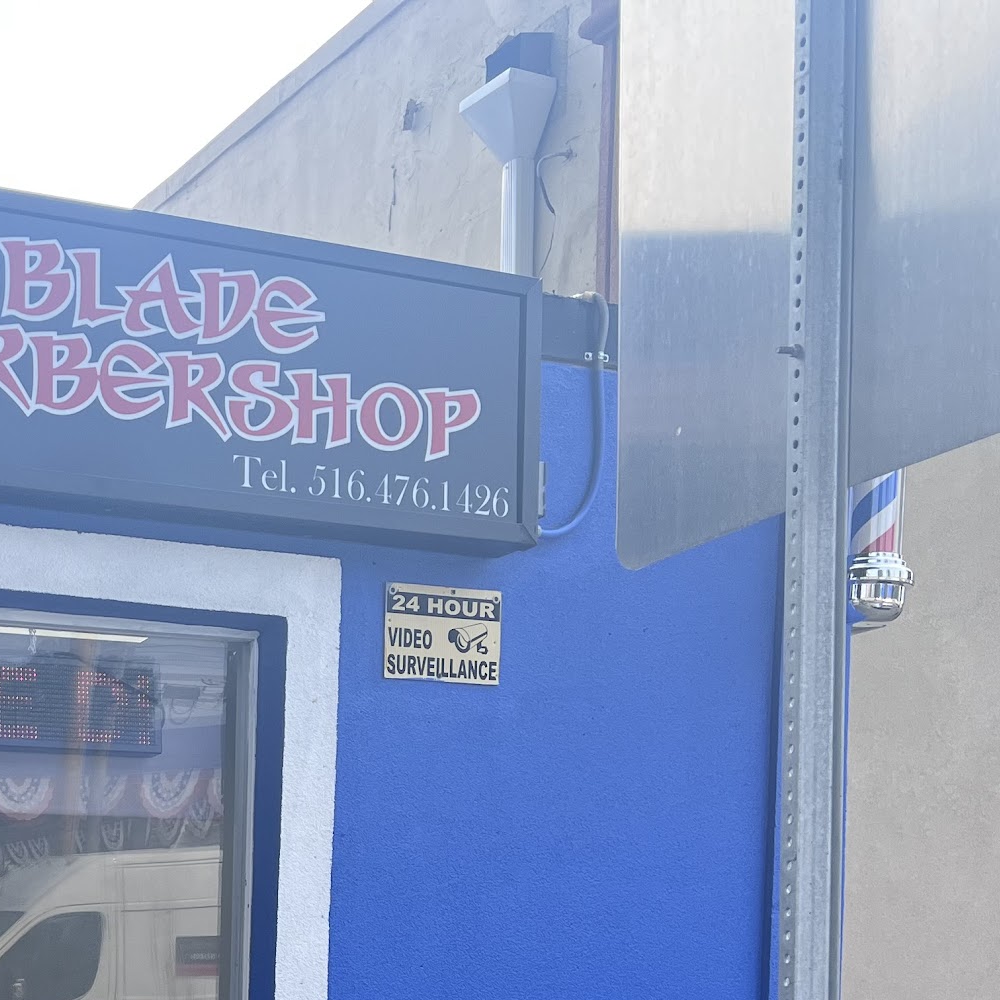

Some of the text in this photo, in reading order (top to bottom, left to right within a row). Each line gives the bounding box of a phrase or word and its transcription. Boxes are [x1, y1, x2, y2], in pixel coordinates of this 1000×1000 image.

[232, 454, 510, 518] Tel. 516.476.1426
[391, 594, 496, 619] 24 HOUR
[387, 626, 433, 650] VIDEO
[386, 653, 498, 681] SURVEILLANCE
